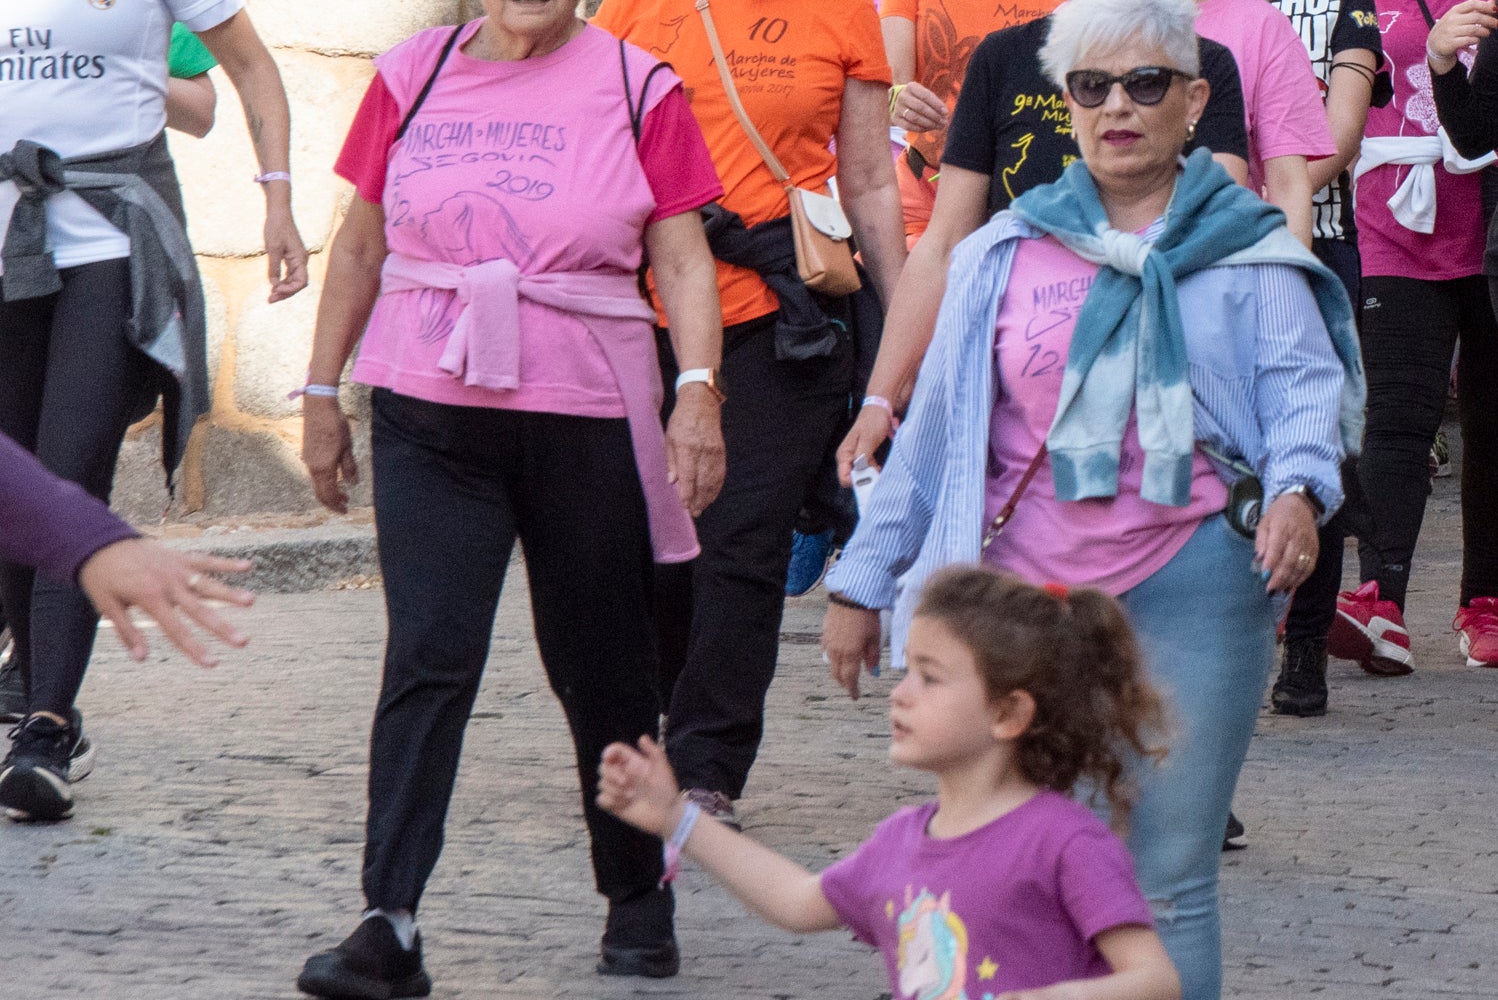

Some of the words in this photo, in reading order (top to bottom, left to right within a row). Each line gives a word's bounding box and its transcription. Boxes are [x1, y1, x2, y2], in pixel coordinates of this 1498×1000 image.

[993, 4, 1048, 19] March
[9, 27, 52, 50] Fly
[748, 17, 788, 43] 10
[0, 49, 105, 81] irates
[780, 55, 797, 67] de
[486, 121, 567, 152] MUJERES
[486, 169, 556, 202] 2019
[1033, 276, 1094, 311] MARCH
